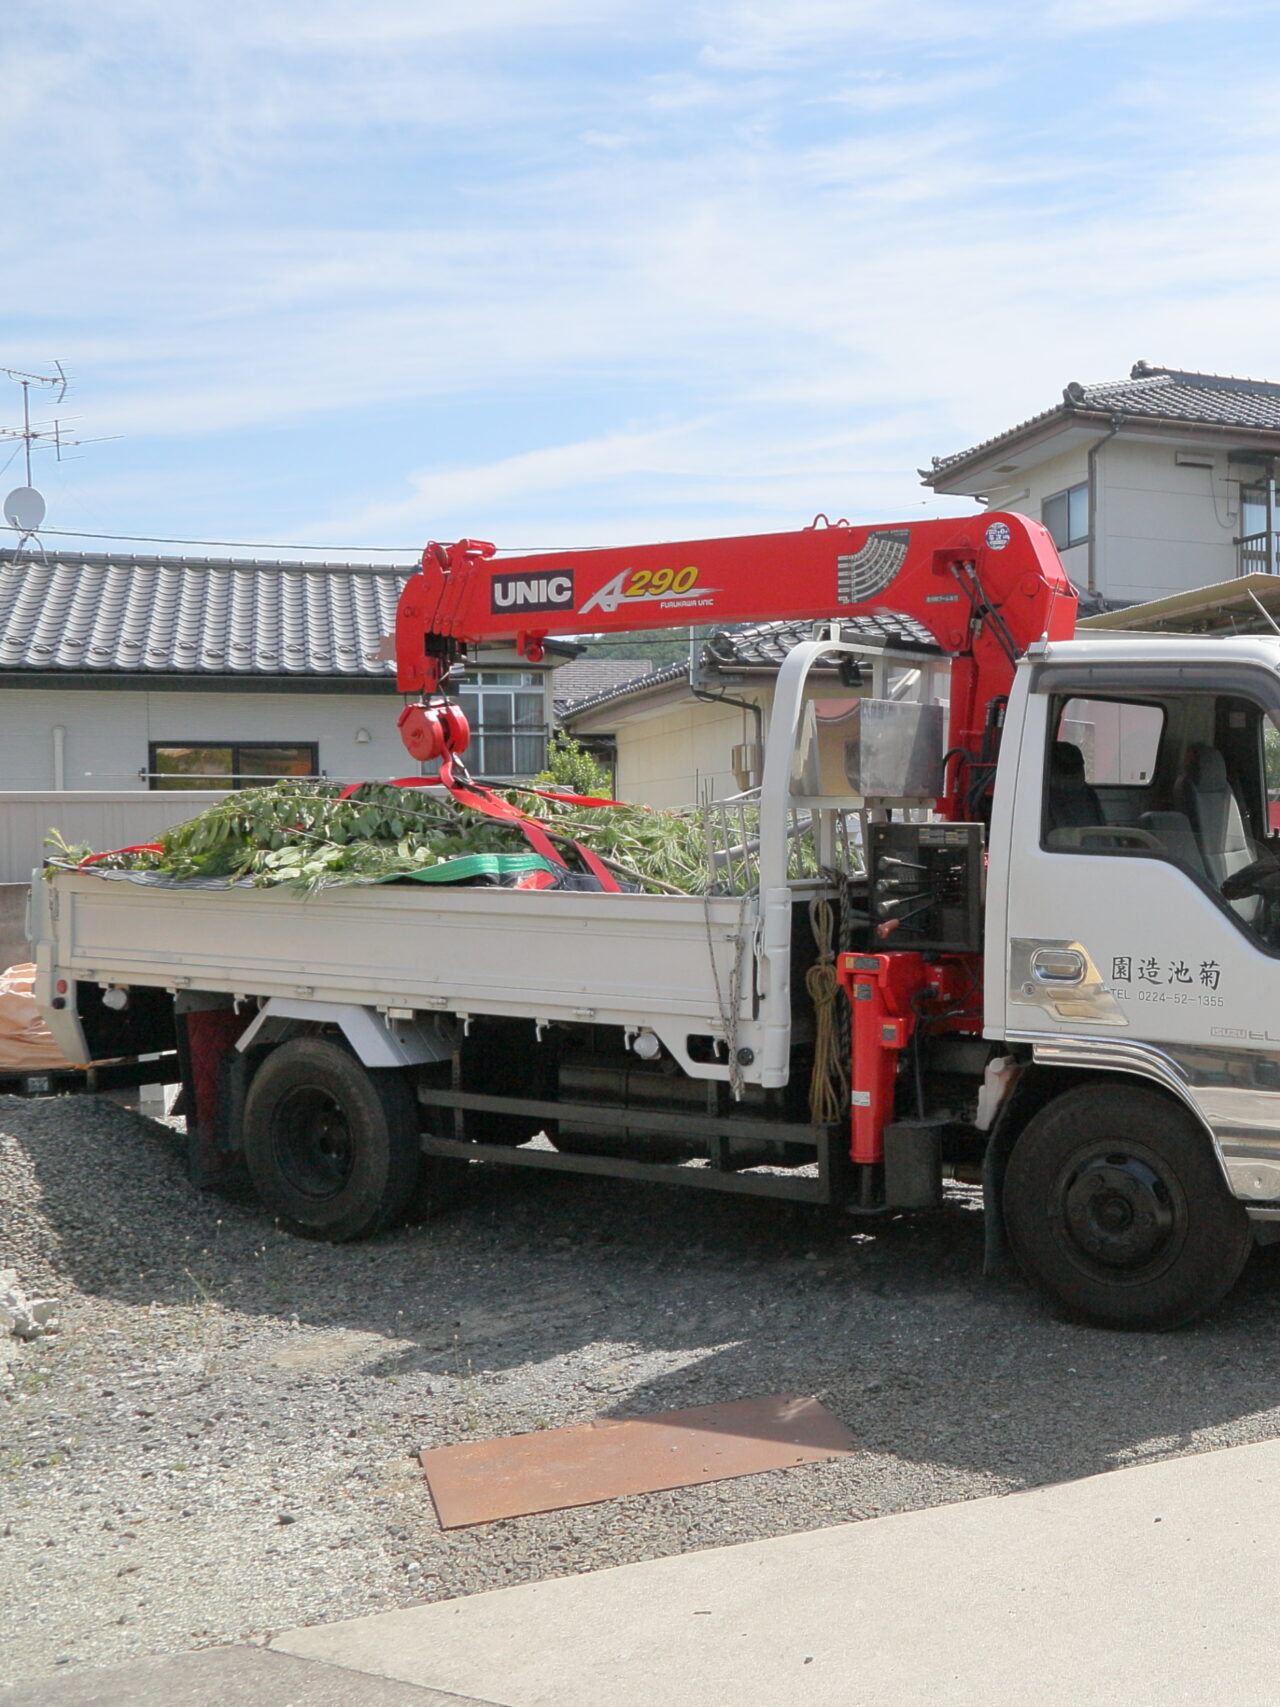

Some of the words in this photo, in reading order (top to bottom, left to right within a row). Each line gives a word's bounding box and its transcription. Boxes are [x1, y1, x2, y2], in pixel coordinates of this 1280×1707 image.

[494, 576, 572, 607] UNIC
[1109, 988, 1131, 1000] TEL
[1138, 990, 1224, 1007] 0224-52-1355
